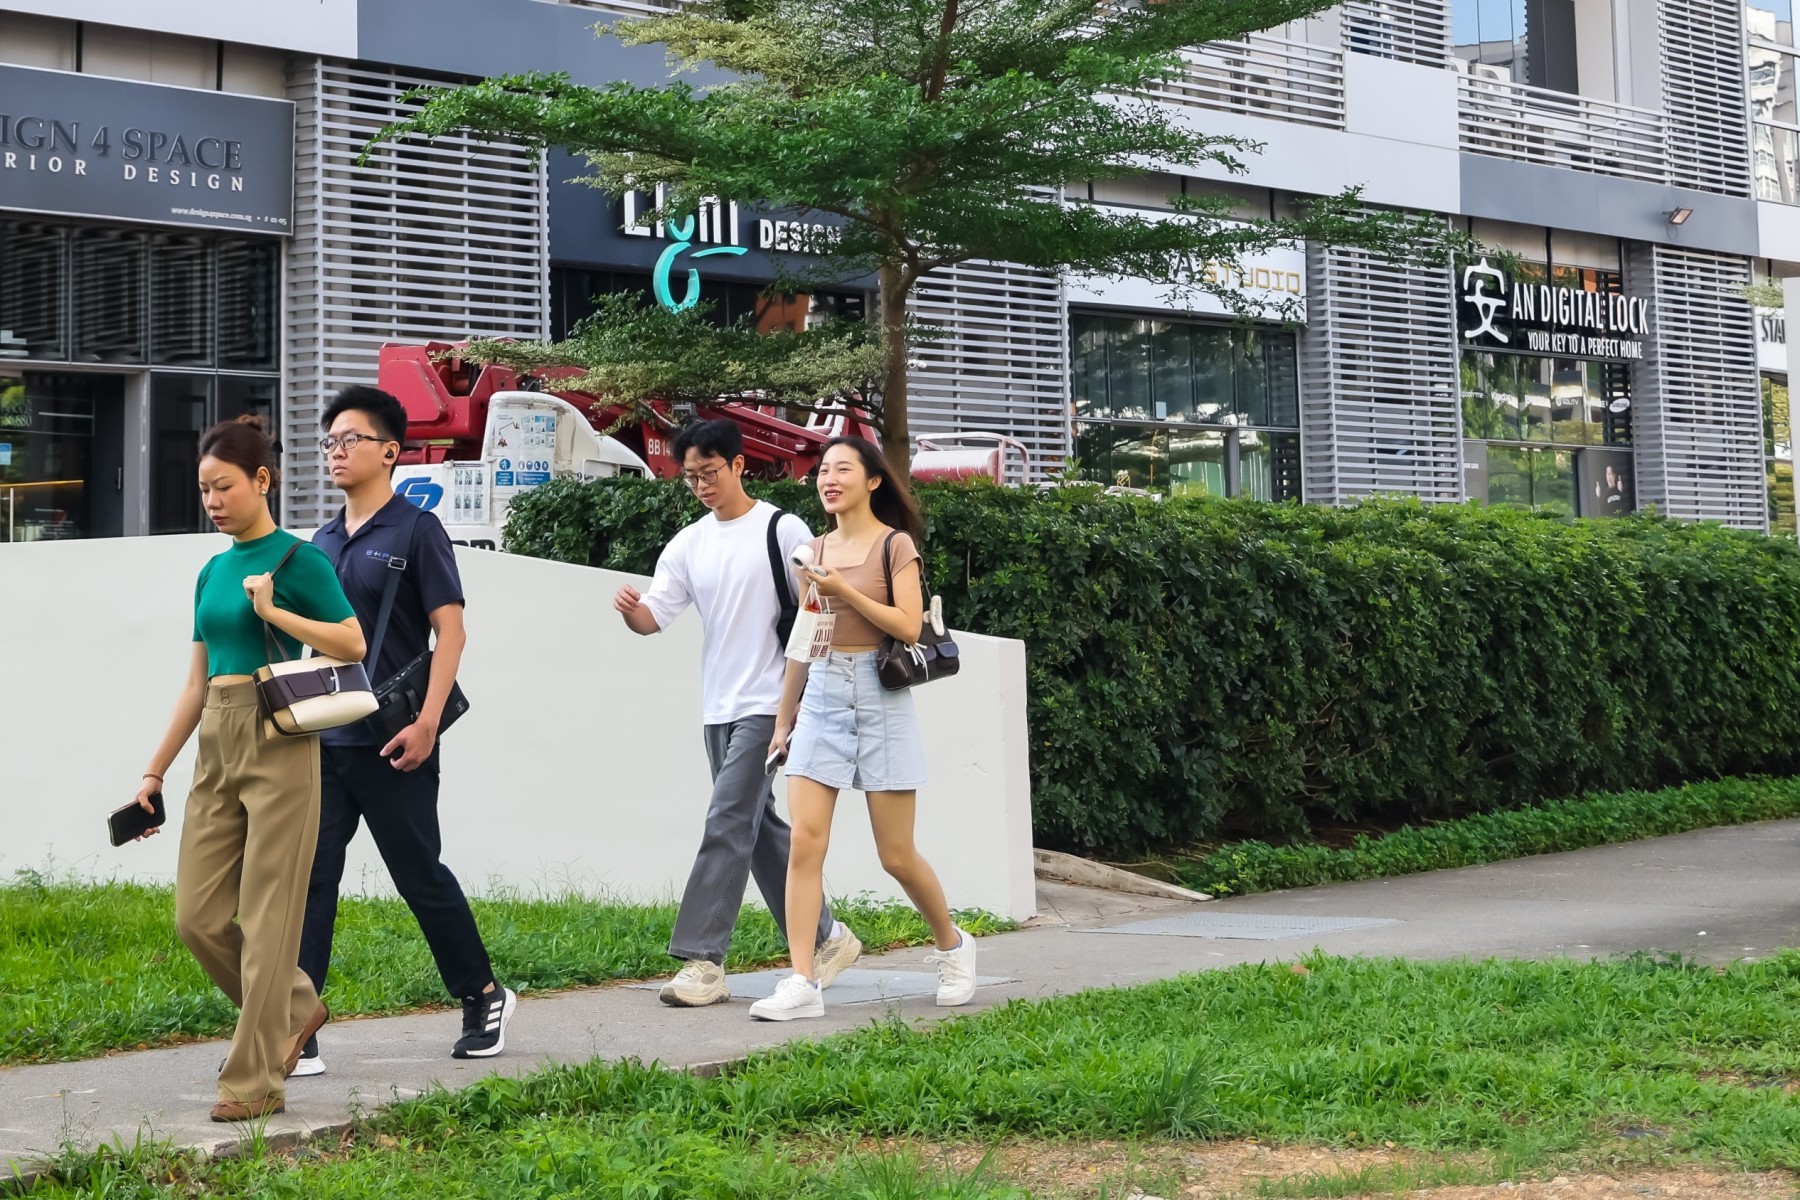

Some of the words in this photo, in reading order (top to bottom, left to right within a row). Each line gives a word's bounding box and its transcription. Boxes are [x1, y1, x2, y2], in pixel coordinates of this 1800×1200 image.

[91, 126, 111, 156] 4
[122, 127, 242, 169] SPACE
[5, 151, 87, 175] RIOR
[124, 164, 243, 192] DESIGN
[1512, 282, 1534, 320] AN
[1540, 285, 1604, 329] DIGITAL
[1609, 294, 1649, 335] LOCK
[1527, 331, 1550, 351] YOUR
[1552, 333, 1567, 353] KEY
[1567, 335, 1578, 354] TO
[1580, 336, 1587, 355] A
[1588, 337, 1619, 358] PERFECT
[1620, 340, 1643, 359] HOME
